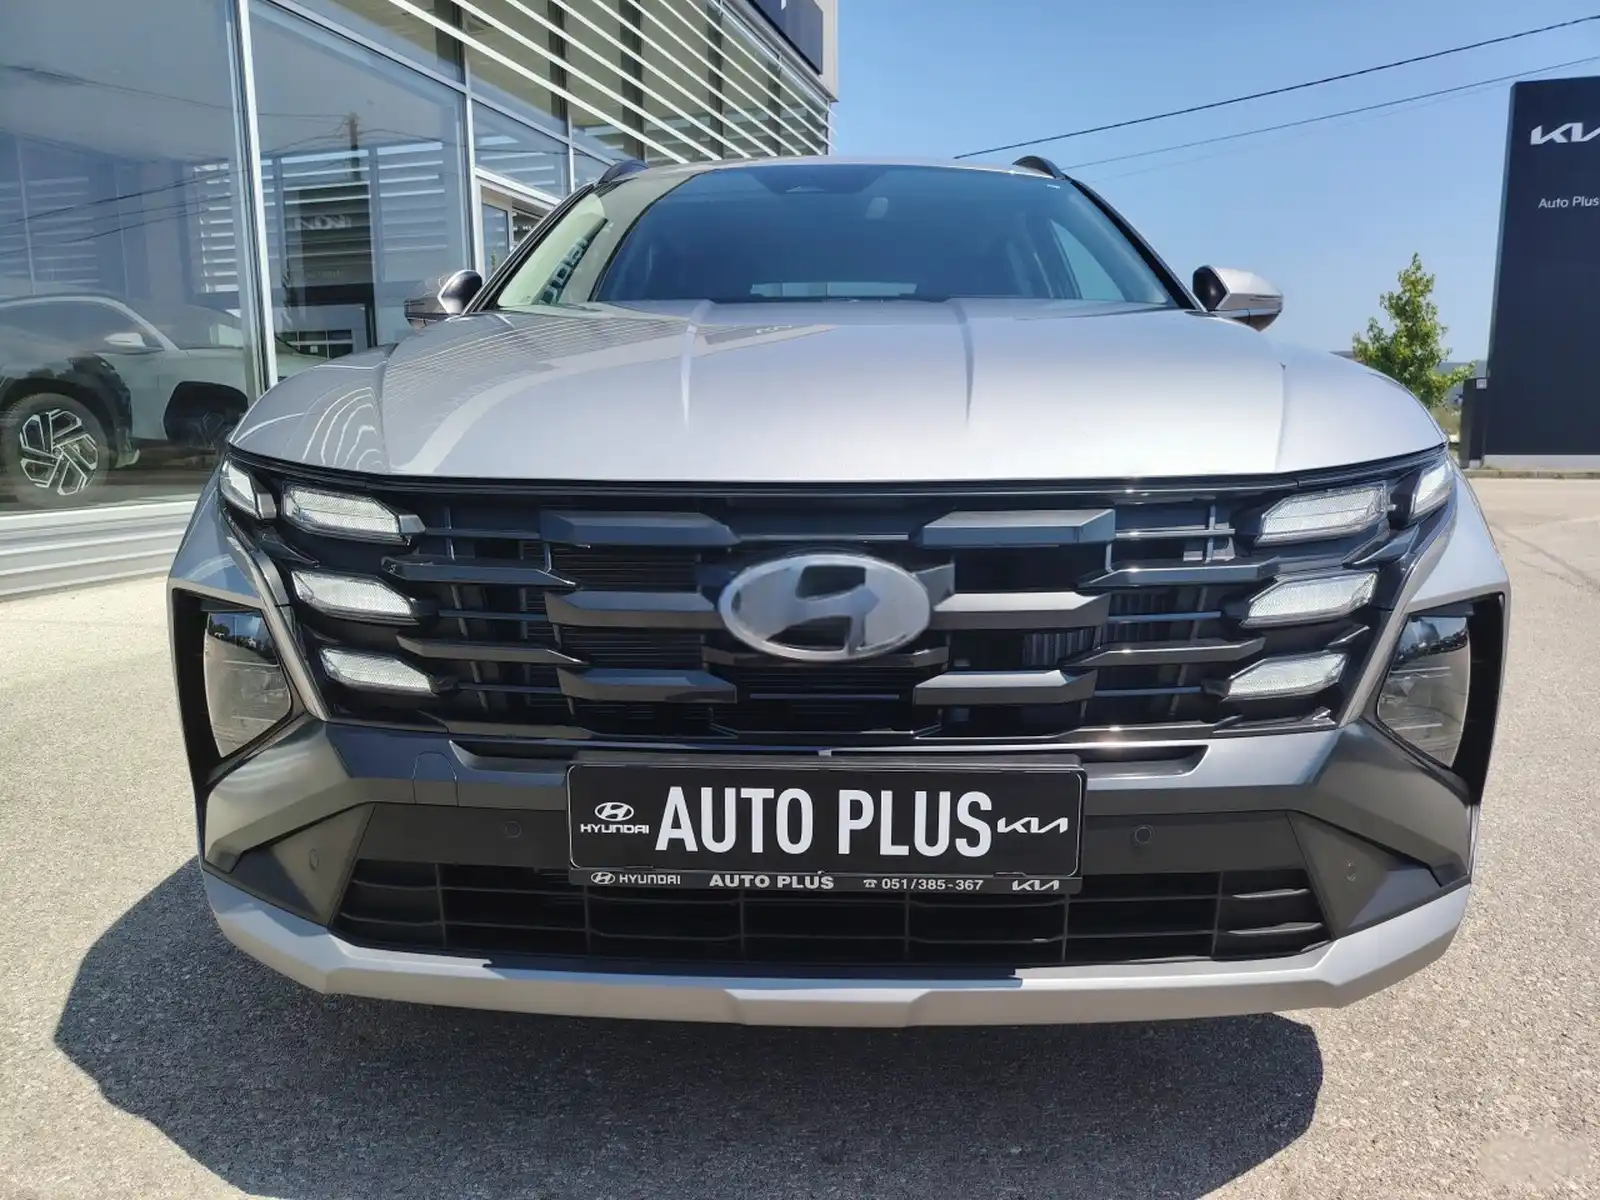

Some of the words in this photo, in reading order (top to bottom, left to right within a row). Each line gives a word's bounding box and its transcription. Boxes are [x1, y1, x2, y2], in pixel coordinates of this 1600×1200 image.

[1538, 198, 1569, 209] Auto
[1572, 196, 1600, 208] Plus
[655, 786, 814, 855] AUTO
[838, 789, 993, 858] PLUS
[997, 816, 1069, 835] KIA
[580, 823, 650, 835] HYUNDAI
[619, 873, 681, 885] HYUNDAI
[709, 874, 771, 888] AUTO
[777, 875, 835, 890] PLUS
[881, 878, 984, 891] 051/385-367
[1012, 879, 1060, 891] KIA
